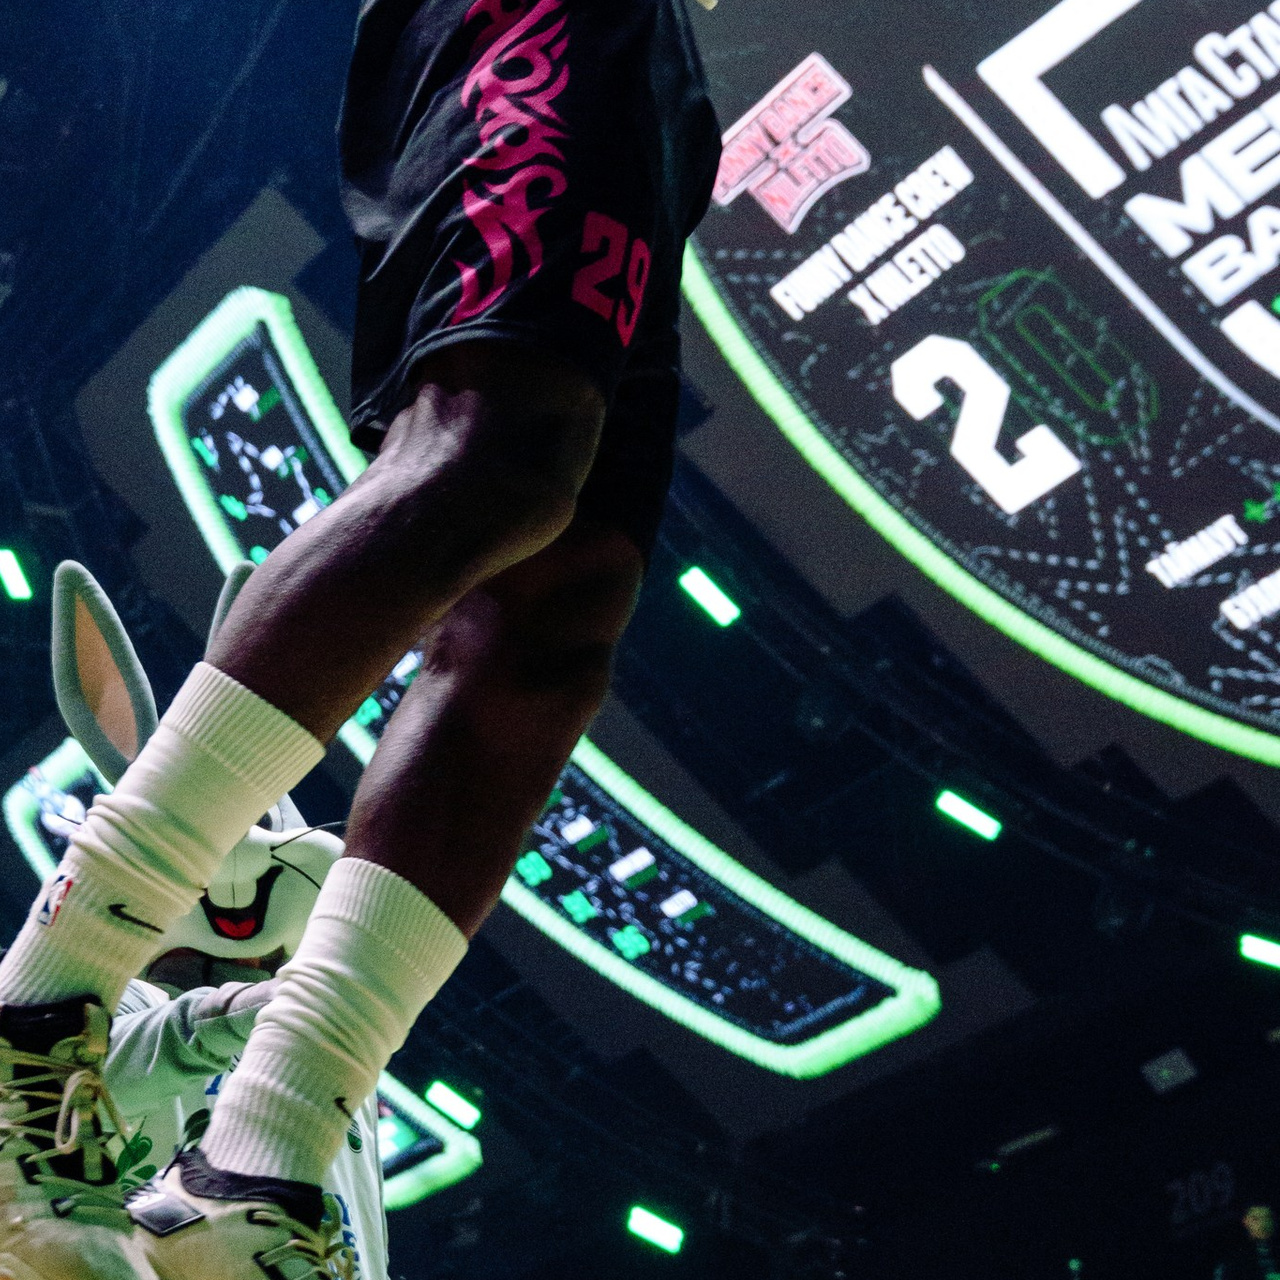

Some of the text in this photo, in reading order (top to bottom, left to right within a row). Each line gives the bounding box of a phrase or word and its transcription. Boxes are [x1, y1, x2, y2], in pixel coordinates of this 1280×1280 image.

[571, 210, 652, 348] 29
[768, 242, 855, 322] FUNNY
[828, 190, 920, 273] DANCE
[864, 222, 967, 313] NILETTO
[890, 334, 1082, 516] 2
